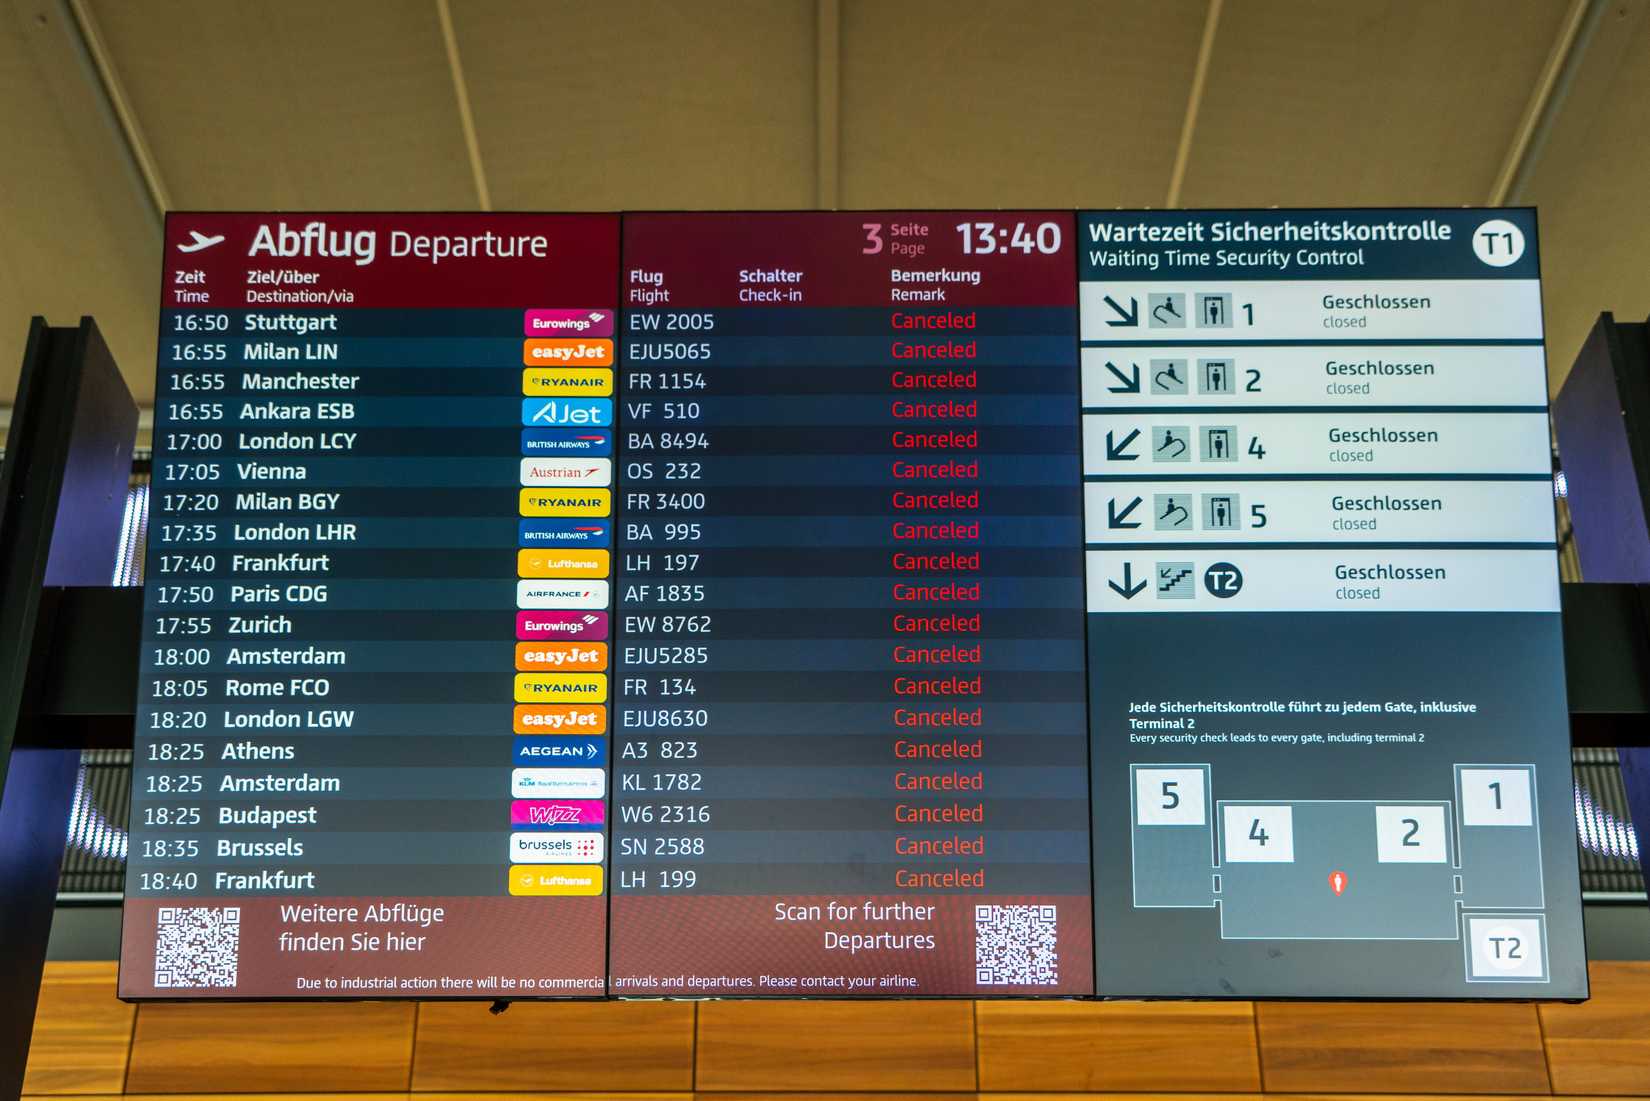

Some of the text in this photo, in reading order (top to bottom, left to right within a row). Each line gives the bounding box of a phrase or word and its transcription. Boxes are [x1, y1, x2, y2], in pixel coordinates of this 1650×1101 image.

[890, 222, 929, 236] Seite
[1089, 220, 1452, 242] Wartezeit Sicherheitskontrolle
[248, 221, 548, 266] Abflug Departure
[862, 223, 883, 255] 3
[956, 222, 1062, 255] 13:40
[1480, 232, 1513, 255] T1
[891, 242, 926, 258] Page
[1089, 248, 1365, 271] Waiting Time Security Control
[175, 269, 206, 284] Zeit
[247, 269, 320, 286] Ziel/über
[630, 268, 663, 287] Flug
[739, 268, 803, 283] Schalter
[891, 267, 981, 286] Bemerkung
[174, 289, 210, 303] Time
[246, 288, 354, 305] Destination/via
[630, 288, 670, 306] Flight
[739, 287, 802, 302] Check-in
[891, 287, 946, 301] Remark
[1322, 294, 1431, 310] Geschlossen
[174, 314, 229, 331] 16:50
[630, 313, 714, 330] EW 2005
[891, 311, 976, 329] Canceled
[1242, 303, 1254, 326] 1
[1323, 315, 1367, 329] closed
[244, 314, 338, 336] Stuttgart
[532, 317, 591, 331] Eurowings
[172, 343, 227, 361] 16:55
[243, 342, 338, 361] Milan LIN
[531, 344, 605, 361] easyJet
[1325, 360, 1435, 376] Geschlossen
[171, 373, 225, 391] 16:55
[242, 371, 360, 390] Manchester
[541, 377, 605, 387] RYANAIR
[629, 373, 707, 390] FR 1154
[1245, 369, 1262, 393] 2
[1326, 382, 1370, 395] closed
[239, 401, 355, 420] Ankara ESB
[167, 433, 222, 451] 17:00
[628, 432, 709, 449] BA 8494
[892, 430, 978, 449] Canceled
[1329, 427, 1438, 443] Geschlossen
[1247, 436, 1267, 460] 4
[1329, 448, 1374, 463] closed
[236, 461, 307, 480] Vienna
[530, 466, 582, 479] Austrian
[164, 494, 219, 511] 17:20
[235, 491, 341, 510] Milan BGY
[627, 492, 705, 510] FR 3400
[1331, 495, 1442, 511] Geschlossen
[1251, 504, 1267, 529] 5
[1332, 518, 1377, 531] closed
[234, 522, 357, 541] London LHR
[160, 555, 216, 573] 17:40
[626, 554, 700, 571] LH 197
[892, 551, 980, 571] Canceled
[1208, 570, 1238, 591] T2
[1335, 564, 1446, 580] Geschlossen
[231, 584, 328, 603] Paris CDG
[1335, 586, 1380, 600] closed
[156, 617, 211, 635] 17:55
[625, 615, 711, 633] EW 8762
[226, 646, 346, 665] Amsterdam
[152, 679, 208, 697] 18:05
[624, 678, 697, 696] FR 134
[894, 675, 981, 695] Canceled
[1128, 700, 1477, 716] Jede Sicherheitskontrolle führt zu jedem Gate, inklusive
[224, 709, 353, 728] London LGW
[1129, 717, 1195, 729] Terminal 2
[1130, 732, 1425, 745] Every security check leads to every gate, including terminal 2
[148, 743, 204, 761] 18:25
[221, 741, 295, 760] Athens
[519, 746, 584, 757] AEGEAN
[621, 741, 698, 759] A3 823
[1162, 781, 1180, 810] 5
[1488, 782, 1502, 810] 1
[144, 807, 201, 825] 18:25
[219, 805, 318, 829] Budapest
[621, 805, 710, 823] W6 2316
[895, 803, 983, 822] Canceled
[1248, 818, 1270, 847] 4
[1401, 818, 1420, 847] 2
[217, 837, 304, 857] Brussels
[519, 839, 573, 851] brussels
[140, 872, 198, 890] 18:40
[215, 870, 316, 890] Frankfurt
[621, 870, 697, 888] LH 199
[895, 868, 984, 888] Canceled
[280, 903, 444, 928] Weitere Abflüge
[775, 901, 936, 921] Scan for further
[279, 931, 426, 952] finden Sie hier
[824, 931, 936, 955] Departures
[1488, 937, 1522, 959] T2
[297, 977, 322, 989] Due
[324, 977, 338, 989] to
[340, 976, 397, 989] industrial
[400, 977, 437, 989] action
[440, 976, 474, 989] there
[476, 976, 498, 989] will
[500, 975, 516, 989] be
[519, 978, 536, 989] no
[615, 975, 659, 987] arrivals
[661, 974, 684, 988] and
[687, 974, 757, 990] departures.
[759, 974, 798, 987] Please
[800, 975, 845, 987] contact
[847, 977, 877, 990] your
[879, 974, 921, 987] airline.
